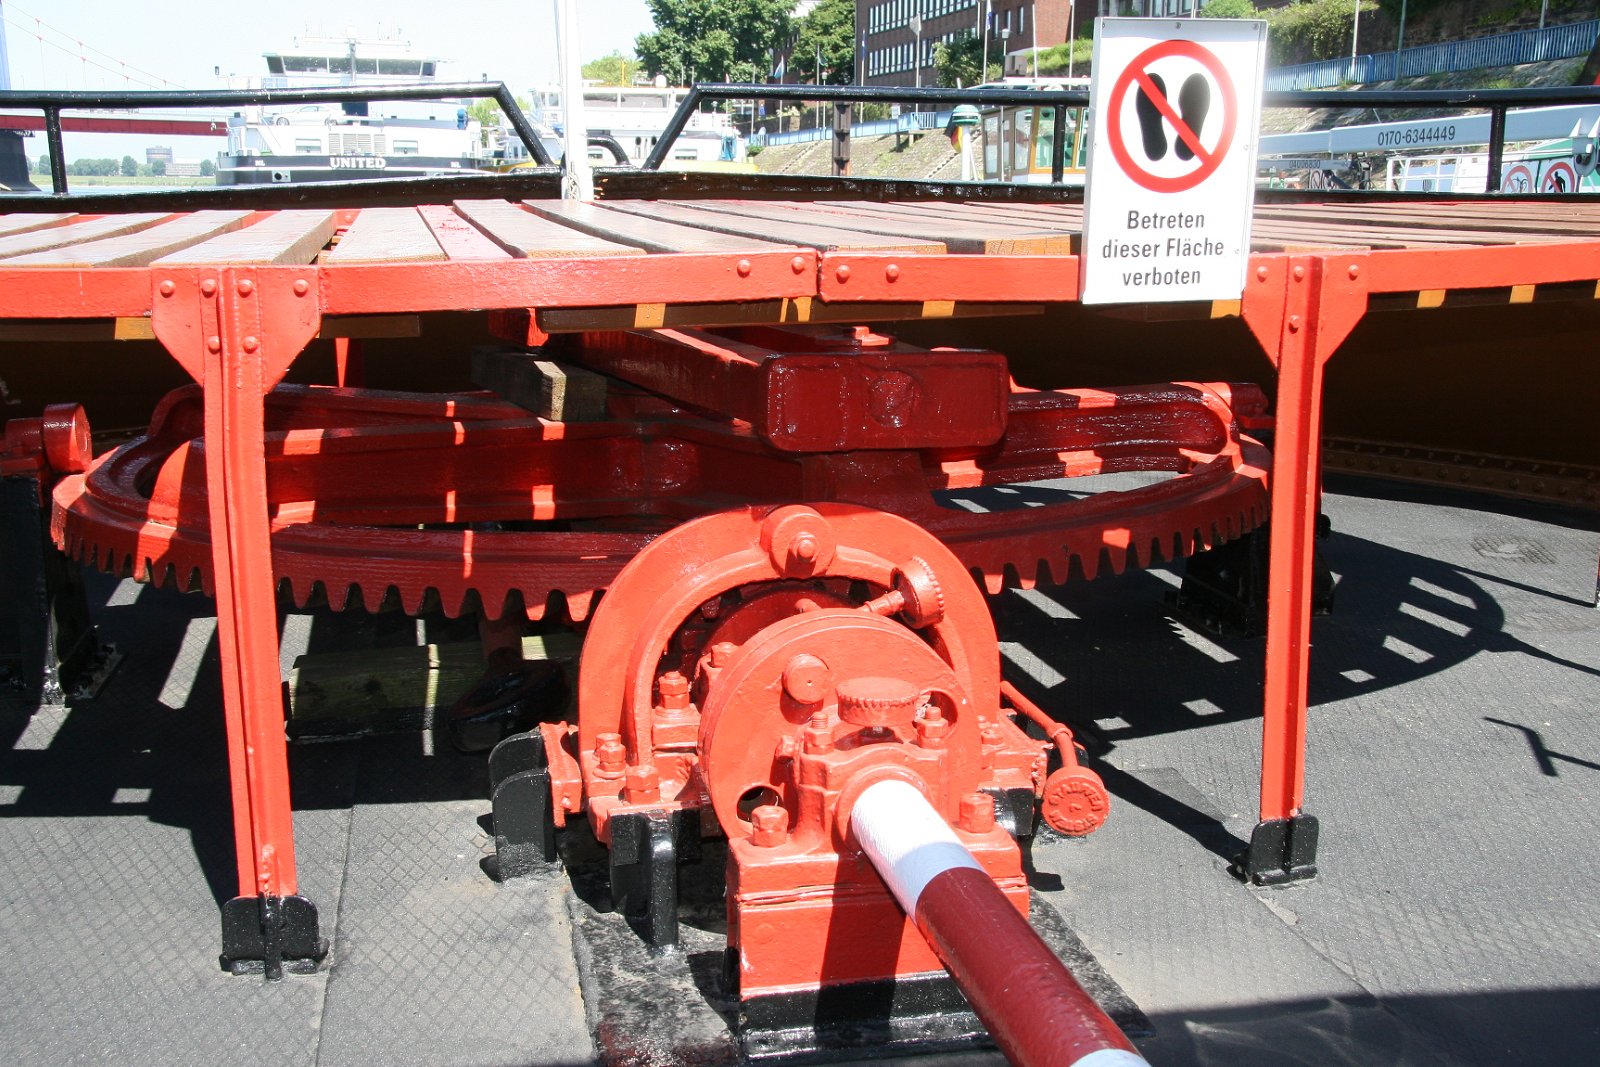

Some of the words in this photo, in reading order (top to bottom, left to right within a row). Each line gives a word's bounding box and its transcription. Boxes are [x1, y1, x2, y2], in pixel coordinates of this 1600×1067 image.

[1377, 125, 1456, 146] 0170-6344449
[329, 157, 387, 169] UNITED
[1126, 210, 1205, 230] Betreten
[1102, 239, 1161, 258] dieser
[1166, 237, 1225, 257] Fläche
[1122, 266, 1201, 286] verboten
